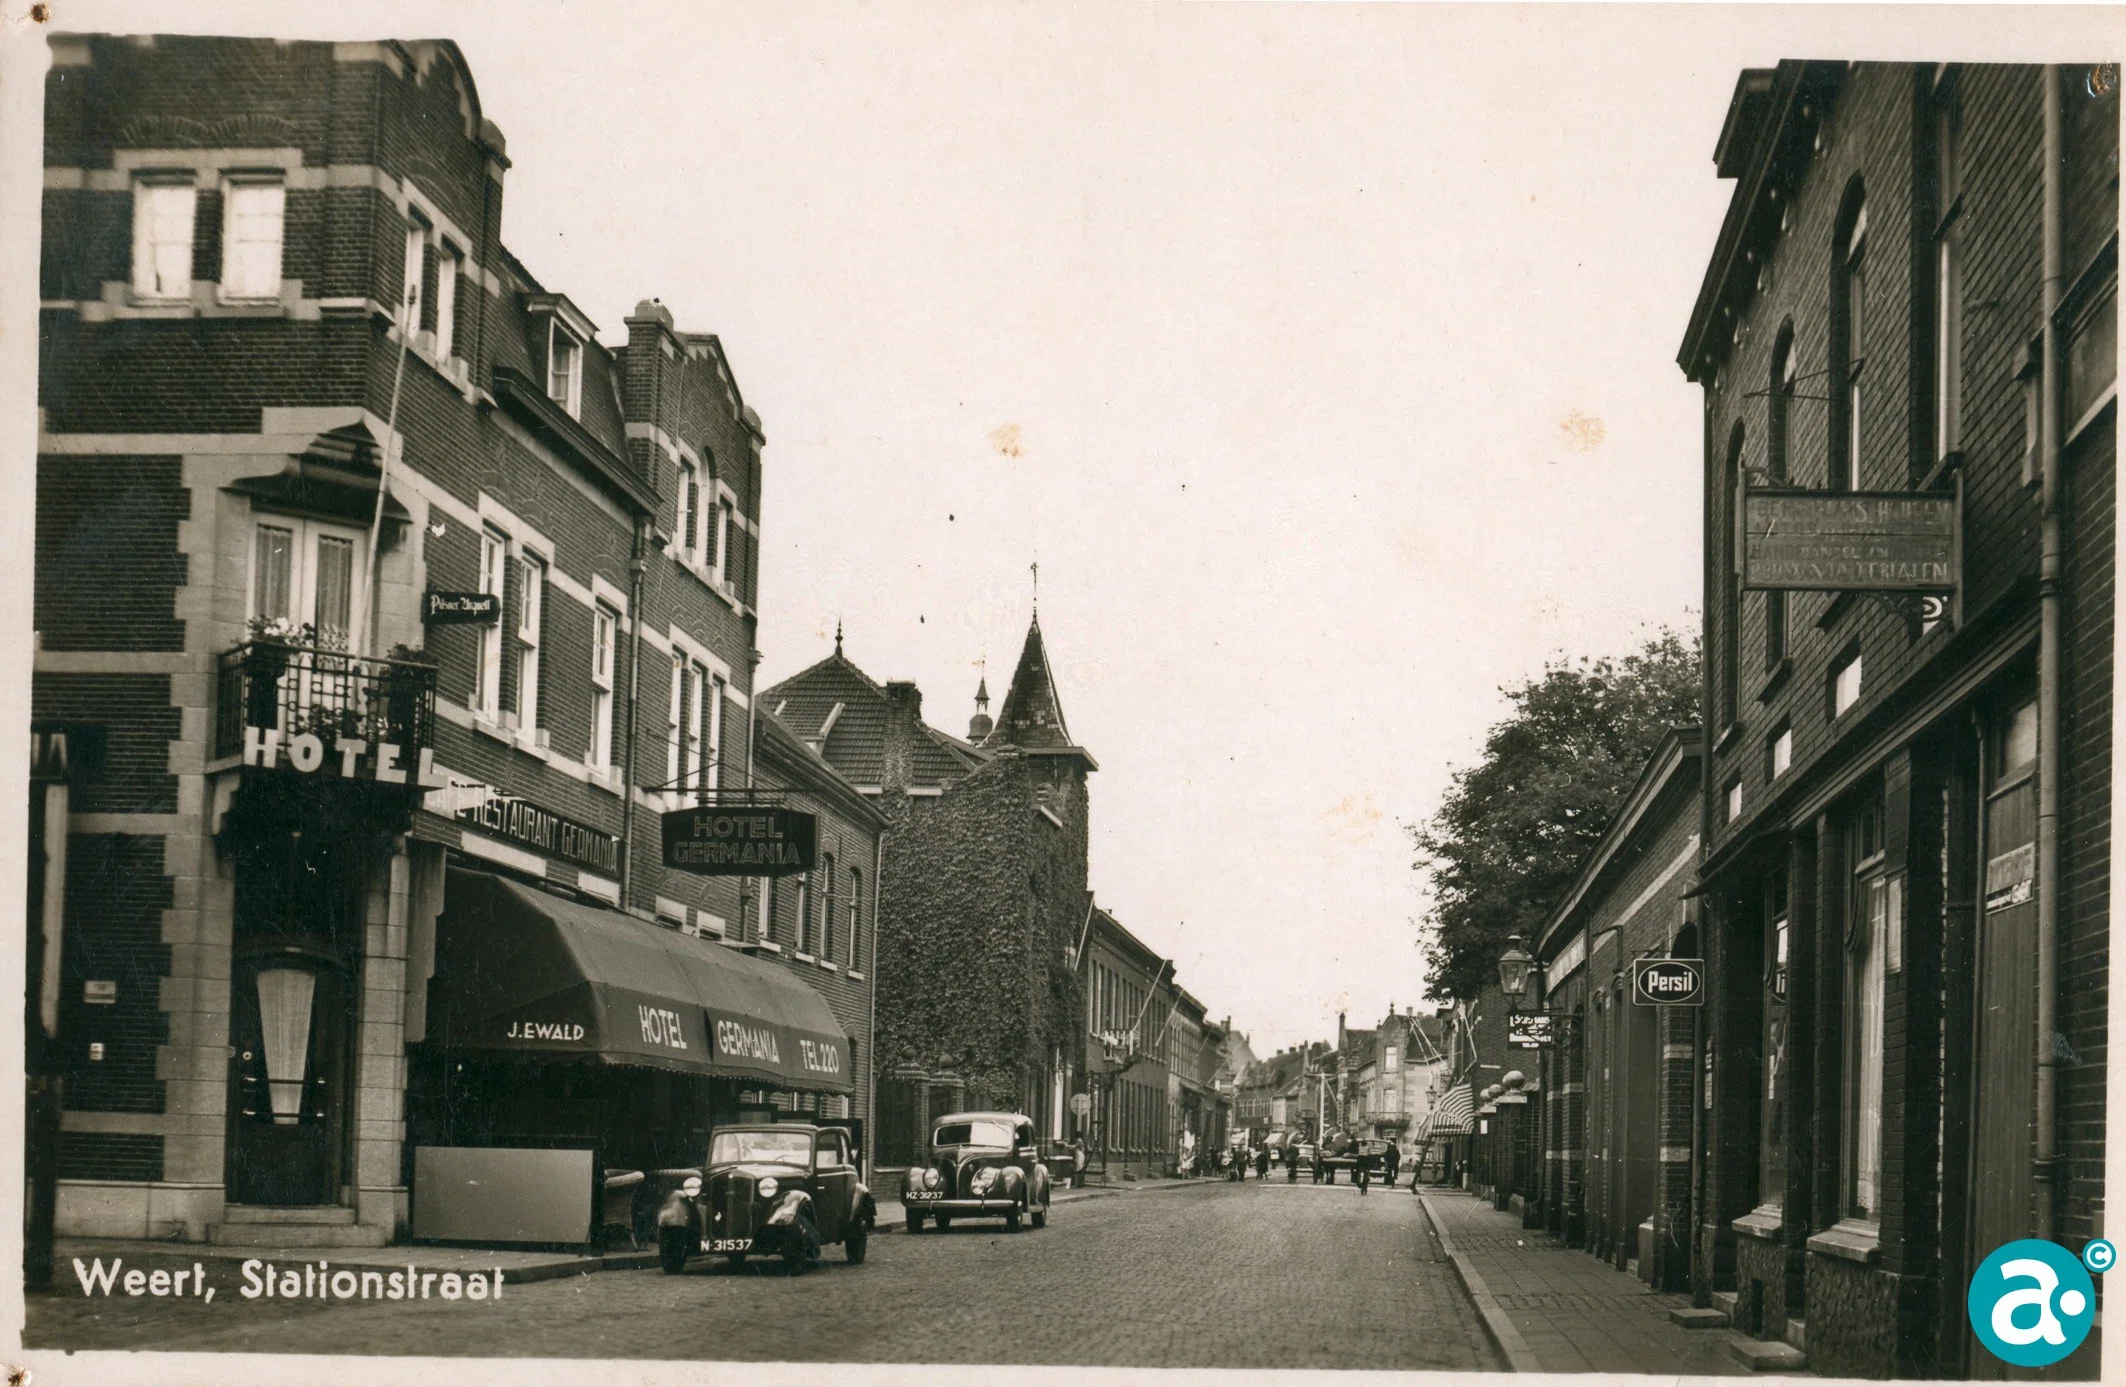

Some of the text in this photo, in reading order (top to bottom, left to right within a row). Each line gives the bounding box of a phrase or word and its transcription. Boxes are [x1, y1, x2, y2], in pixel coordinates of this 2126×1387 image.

[243, 725, 448, 789] HOTEL
[474, 787, 558, 849] RESTAURANT
[561, 822, 618, 872] GERMANIA
[693, 815, 784, 838] HOTEL
[672, 841, 801, 864] GERMANIA
[1648, 970, 1693, 994] Persil
[638, 1004, 688, 1050] HOTEL
[717, 1019, 780, 1064] GERMANIA
[700, 1238, 753, 1252] N-31537
